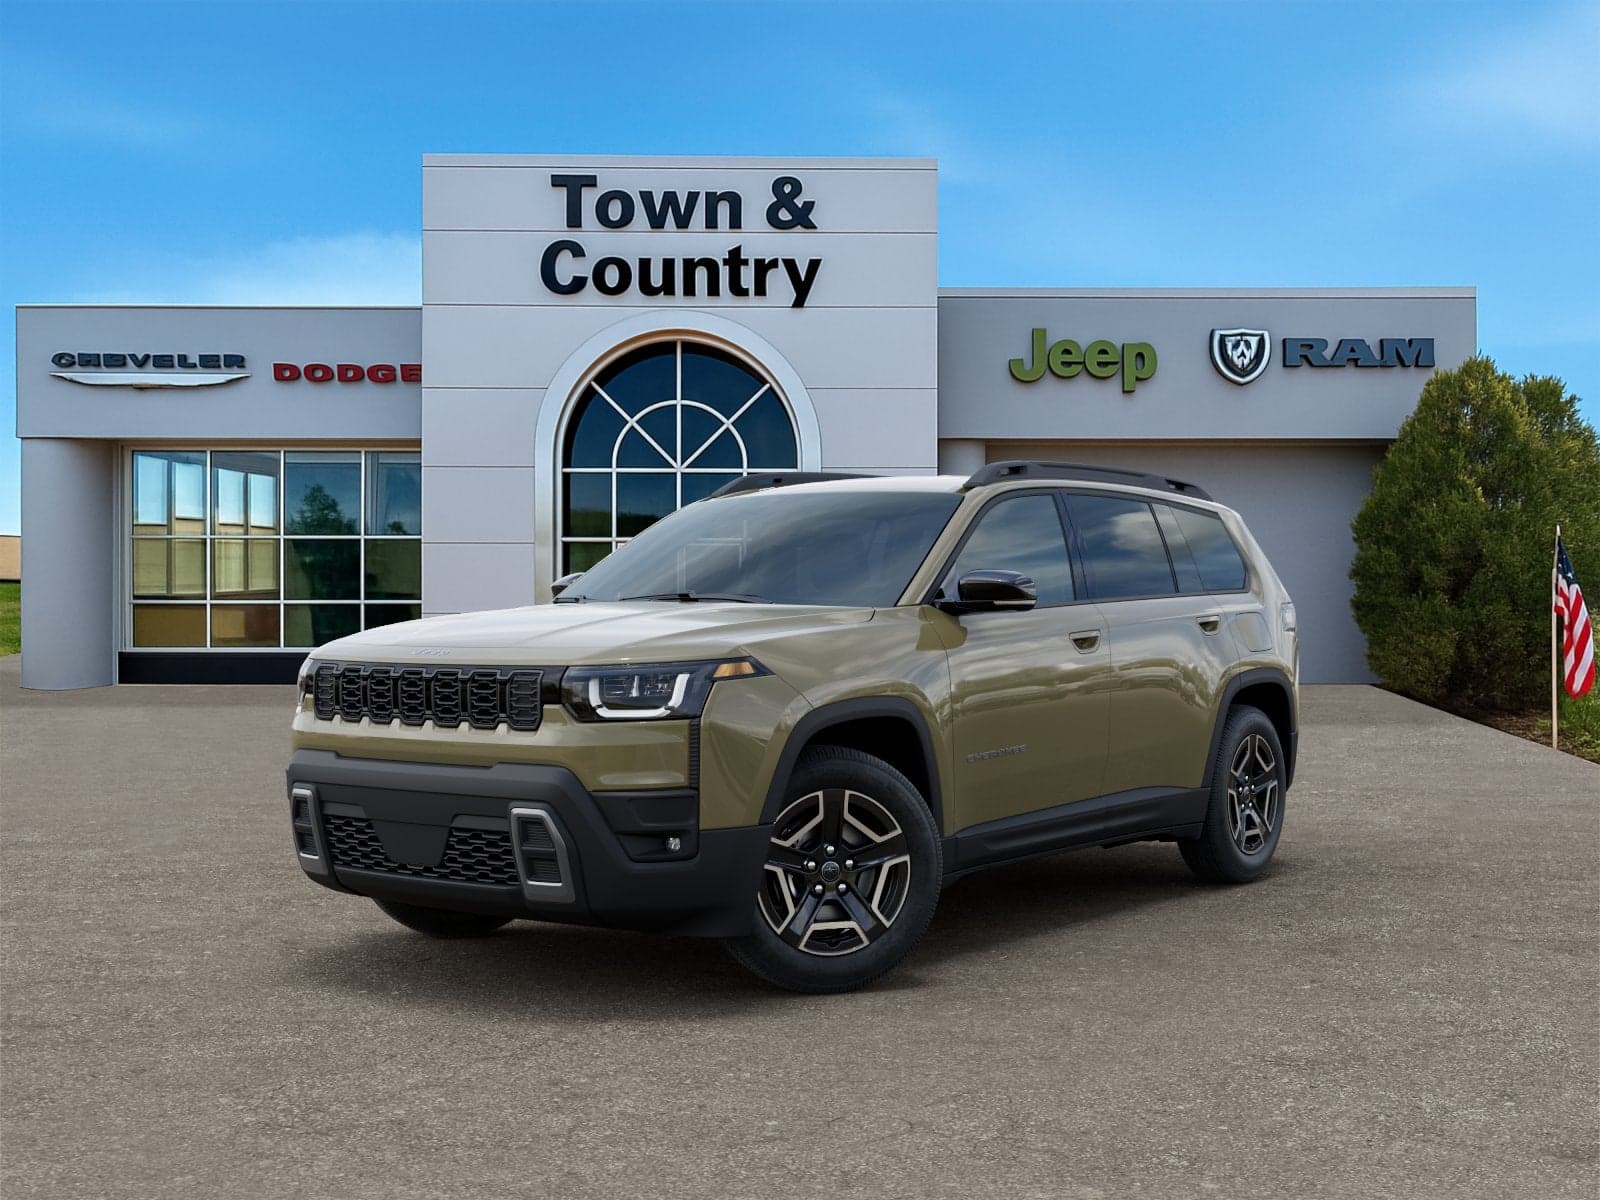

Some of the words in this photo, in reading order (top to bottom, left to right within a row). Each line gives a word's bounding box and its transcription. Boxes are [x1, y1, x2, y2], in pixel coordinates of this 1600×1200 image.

[550, 174, 743, 230] Town
[765, 175, 818, 231] &
[540, 239, 823, 308] Country
[273, 363, 422, 383] DODGE
[1008, 327, 1158, 393] Jeep
[1282, 337, 1435, 368] RAM
